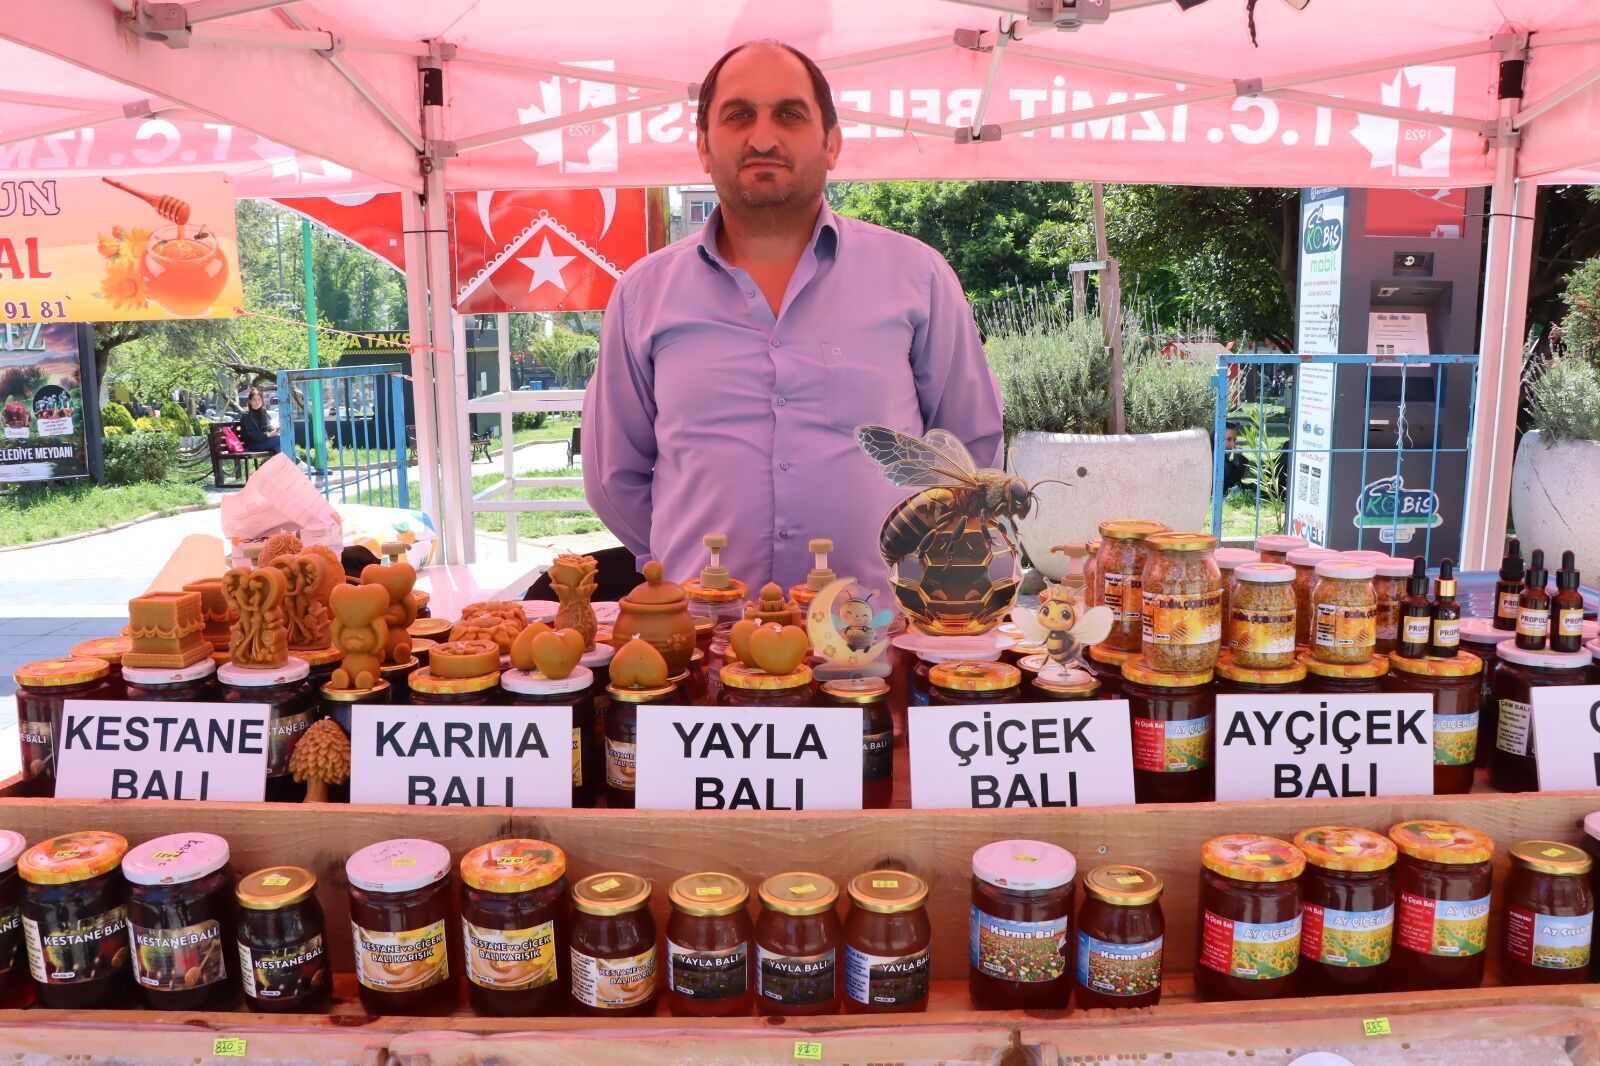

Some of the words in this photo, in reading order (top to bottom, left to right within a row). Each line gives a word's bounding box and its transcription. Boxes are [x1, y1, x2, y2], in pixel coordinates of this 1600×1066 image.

[5, 302, 31, 319] 91
[40, 301, 67, 318] 81
[35, 446, 73, 459] MEYDANI
[65, 715, 265, 754] KESTANE
[1223, 701, 1428, 755] AYÇİÇEK
[376, 721, 550, 759] KARMA
[672, 722, 828, 760] YAYLA
[948, 711, 1096, 766] ÇİÇEK
[111, 768, 209, 800] BALI
[1273, 763, 1377, 798] BALI
[408, 776, 514, 807] BALI
[695, 777, 804, 811] BALI
[970, 771, 1078, 808] BALI
[1446, 906, 1460, 917] AY
[1333, 915, 1348, 927] AY
[44, 930, 102, 946] KESTANE
[136, 934, 190, 949] KESTANE
[190, 926, 218, 944] BALI
[990, 924, 1032, 939] Karma
[1243, 928, 1258, 938] AY
[361, 940, 401, 954] KESTANE
[402, 945, 414, 953] ve
[415, 934, 443, 951] ÇİÇEK
[470, 937, 507, 952] KESTANE
[507, 944, 520, 952] ve
[521, 934, 551, 950] ÇİÇEK
[255, 957, 305, 970] KESTANE
[371, 952, 392, 964] BALI
[393, 948, 434, 964] KARIŞIK
[479, 949, 499, 961] BALI
[499, 949, 541, 962] KARIŞIK
[680, 954, 713, 967] YAYLA
[715, 954, 738, 966] BALI
[1100, 950, 1138, 961] Karma
[599, 966, 638, 977] KESTANE
[769, 959, 801, 973] YAYLA
[804, 960, 827, 972] BALI
[882, 962, 915, 973] YAYLA
[610, 977, 630, 985] BALI
